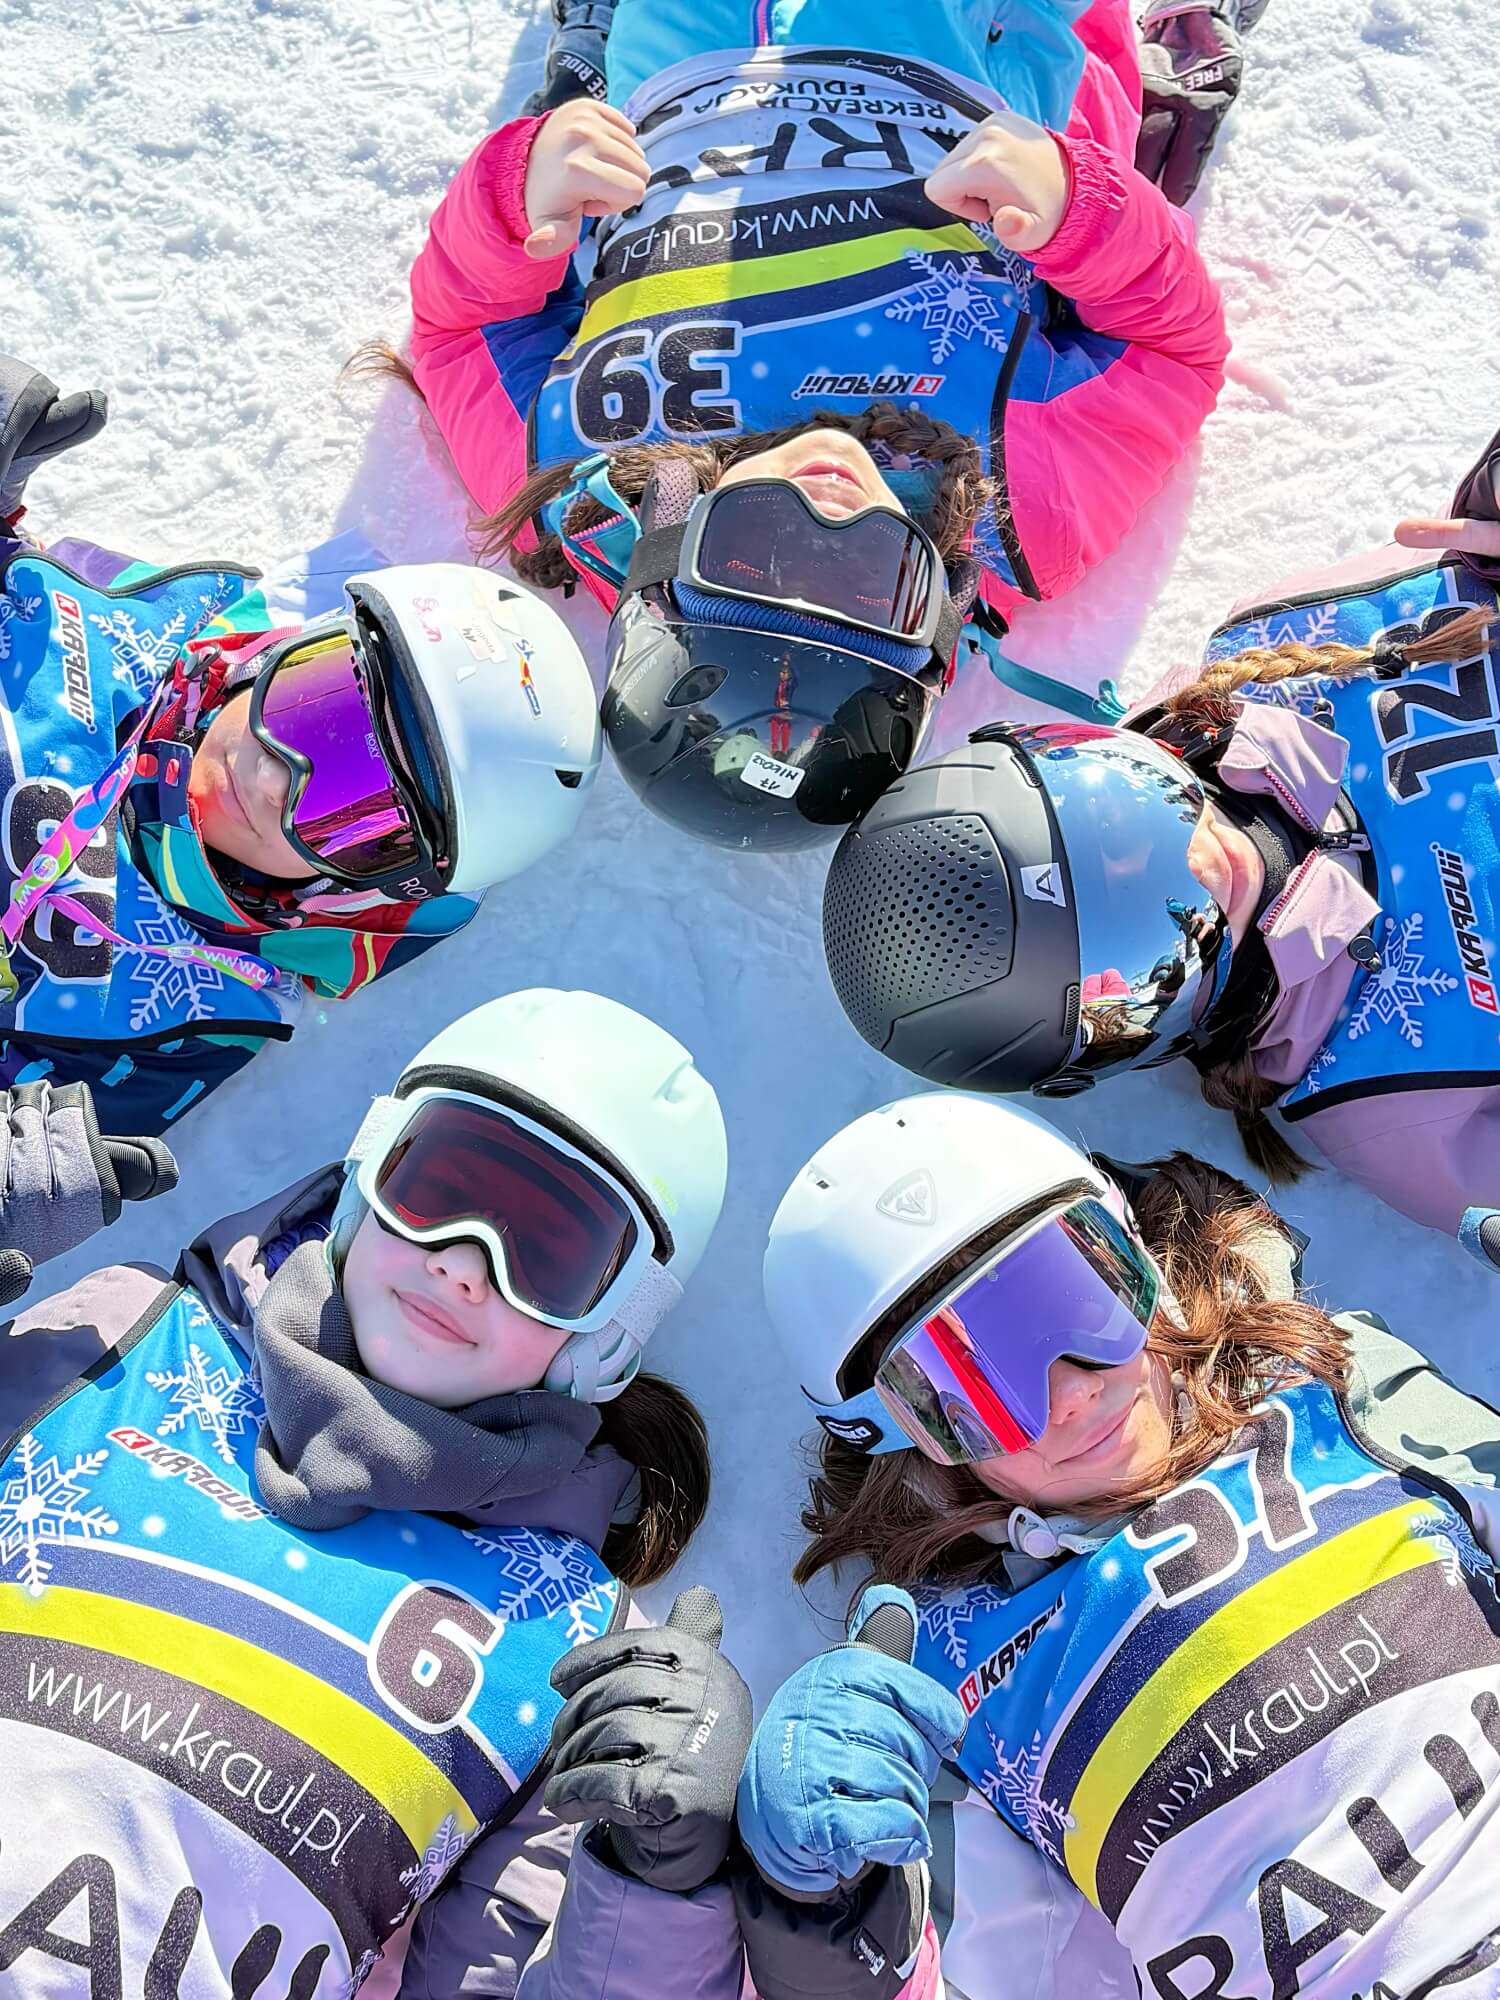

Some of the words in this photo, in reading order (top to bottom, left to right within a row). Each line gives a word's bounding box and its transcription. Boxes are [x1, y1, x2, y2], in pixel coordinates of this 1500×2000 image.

[557, 54, 594, 82] RIDE
[1185, 65, 1223, 91] FREE
[621, 197, 883, 273] www.kraul.pl
[572, 321, 743, 448] 39
[366, 732, 381, 759] ROXY
[1127, 1400, 1317, 1608] 57
[368, 1580, 506, 1733] 6
[27, 1663, 363, 1865] www.kraul.pl
[687, 1707, 720, 1755] WEDZE
[1126, 1615, 1400, 1868] www.kraul.pl
